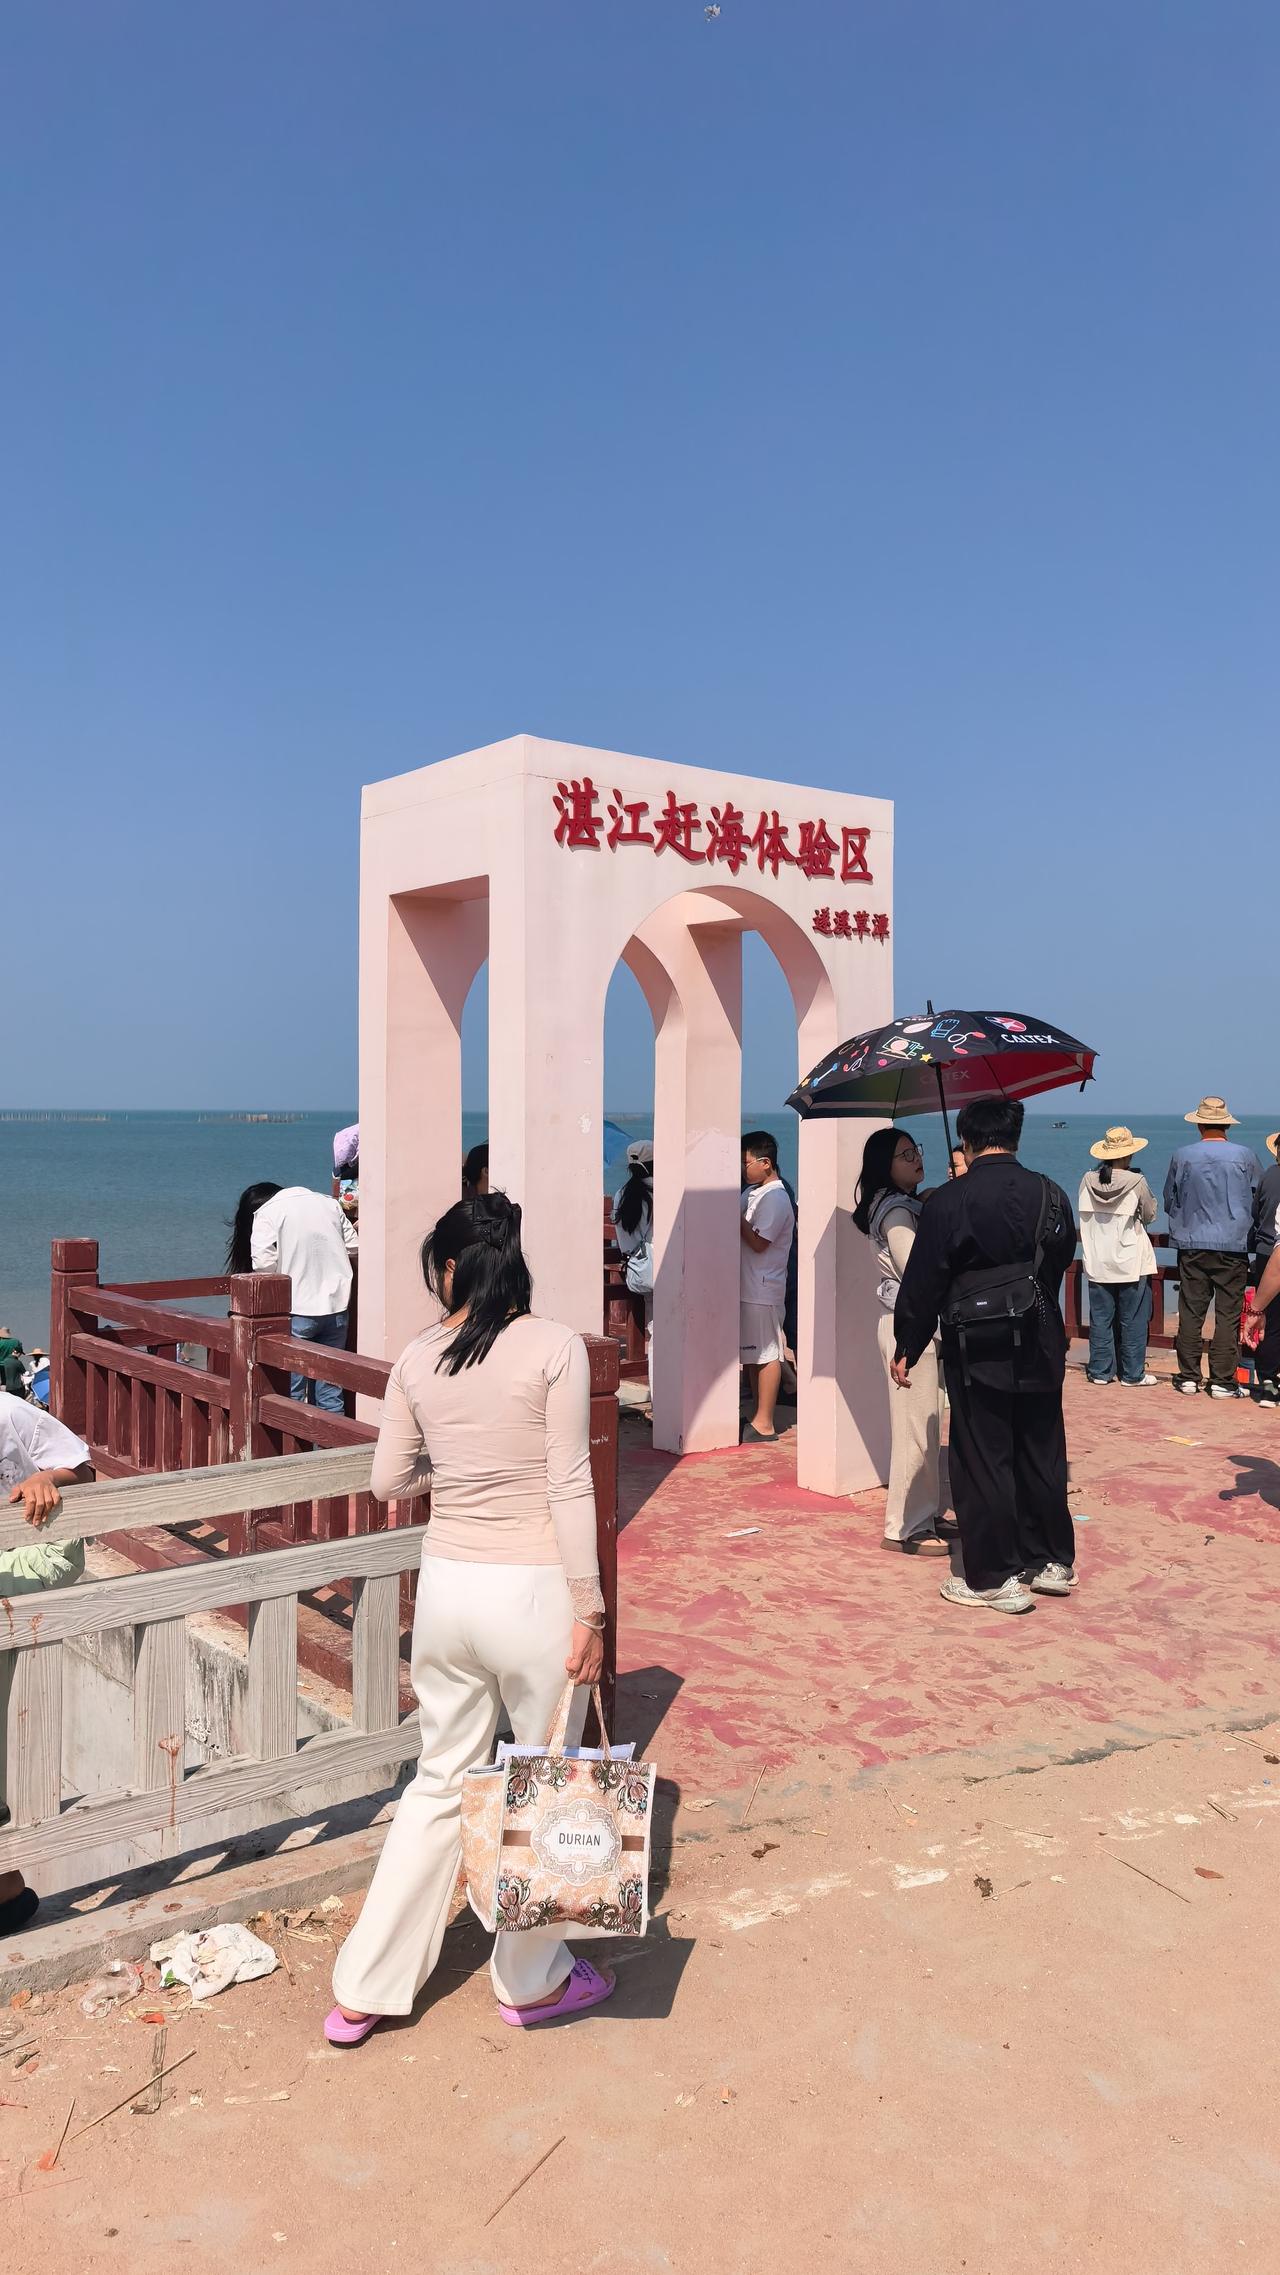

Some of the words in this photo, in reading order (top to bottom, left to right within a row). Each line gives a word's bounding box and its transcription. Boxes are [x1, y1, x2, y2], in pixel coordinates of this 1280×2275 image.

[552, 776, 874, 883] 湛江赶海体验区
[1001, 1034, 1060, 1044] CALTEX
[558, 1832, 601, 1846] DURIAN
